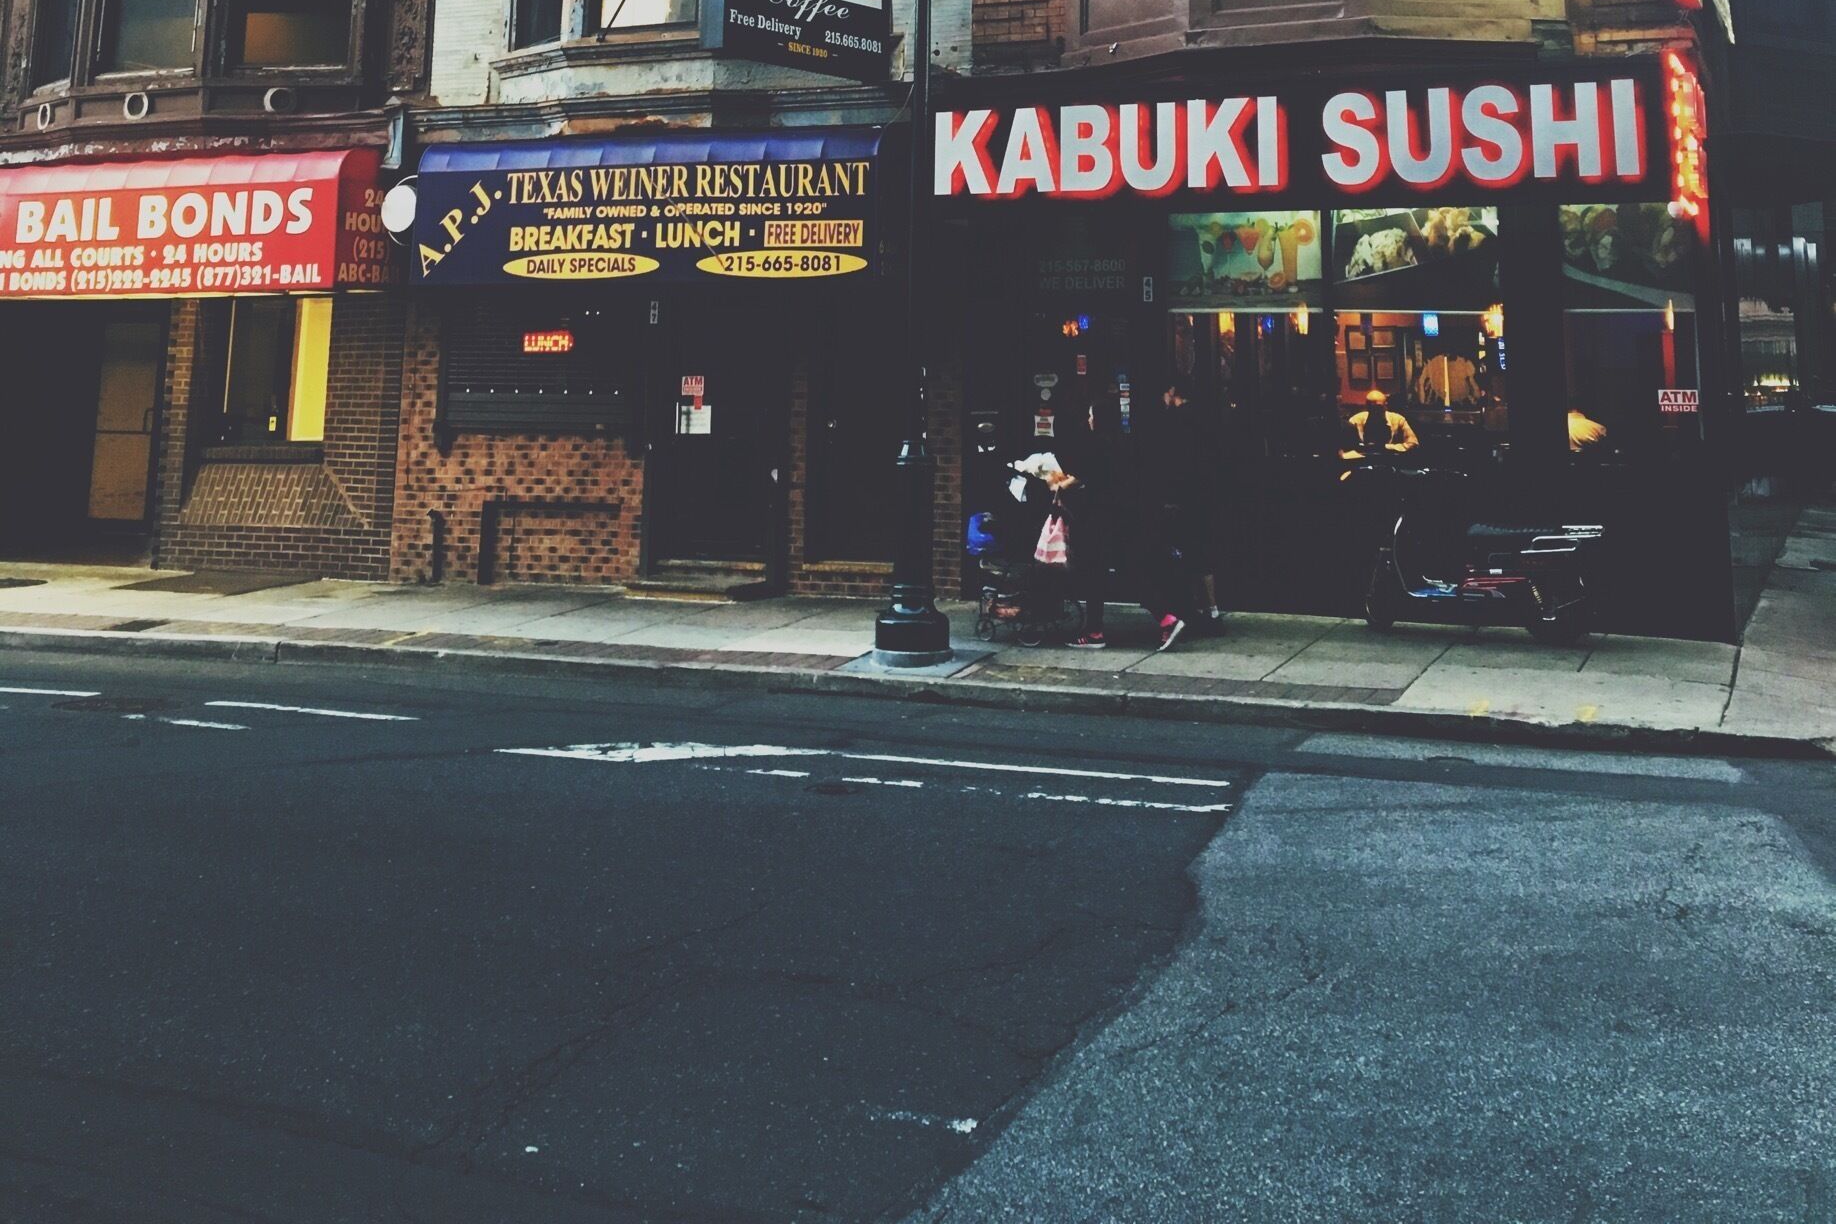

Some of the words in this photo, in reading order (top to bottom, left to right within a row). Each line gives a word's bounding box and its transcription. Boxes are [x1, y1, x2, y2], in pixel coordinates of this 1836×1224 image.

[730, 9, 755, 27] Free
[758, 15, 802, 40] Delivery
[788, 41, 811, 55] SINCE
[825, 30, 882, 54] 215.665.8081
[934, 96, 1280, 196] KABUKI
[1321, 79, 1641, 186] SUSHI
[507, 170, 583, 205] TEXAS
[590, 165, 690, 201] WEINER
[694, 162, 870, 198] RESTAURANT
[16, 197, 119, 244] BAIL
[137, 187, 314, 239] BONDS
[543, 206, 594, 220] "FAMILY
[596, 205, 647, 218] OWNED
[650, 205, 661, 217] &
[664, 202, 735, 217] OPERATED
[738, 202, 781, 216] SINCE
[786, 202, 828, 215] 1920"
[419, 180, 503, 278] A.P.J.
[510, 223, 635, 251] BREAKFAST
[655, 220, 740, 248] LUNCH
[767, 223, 796, 244] FREE
[800, 222, 860, 244] DELIVERY
[30, 248, 65, 268] ALL
[70, 245, 145, 268] COURTS
[162, 243, 187, 264] 24
[193, 242, 263, 263] HOURS
[353, 235, 390, 264] (215)
[527, 258, 566, 274] DAILY
[569, 257, 636, 273] SPECIALS
[724, 255, 842, 272] 215-665-8081
[9, 270, 67, 292] BONDS
[71, 267, 191, 292] (215)222-2245
[197, 264, 322, 289] (877)321-BAIL
[1065, 275, 1126, 290] DELIVER
[1144, 278, 1152, 301] 45
[523, 334, 570, 353] LUNCH
[683, 376, 703, 386] ATM
[1660, 391, 1697, 404] ATM
[1660, 405, 1697, 413] INSIDE
